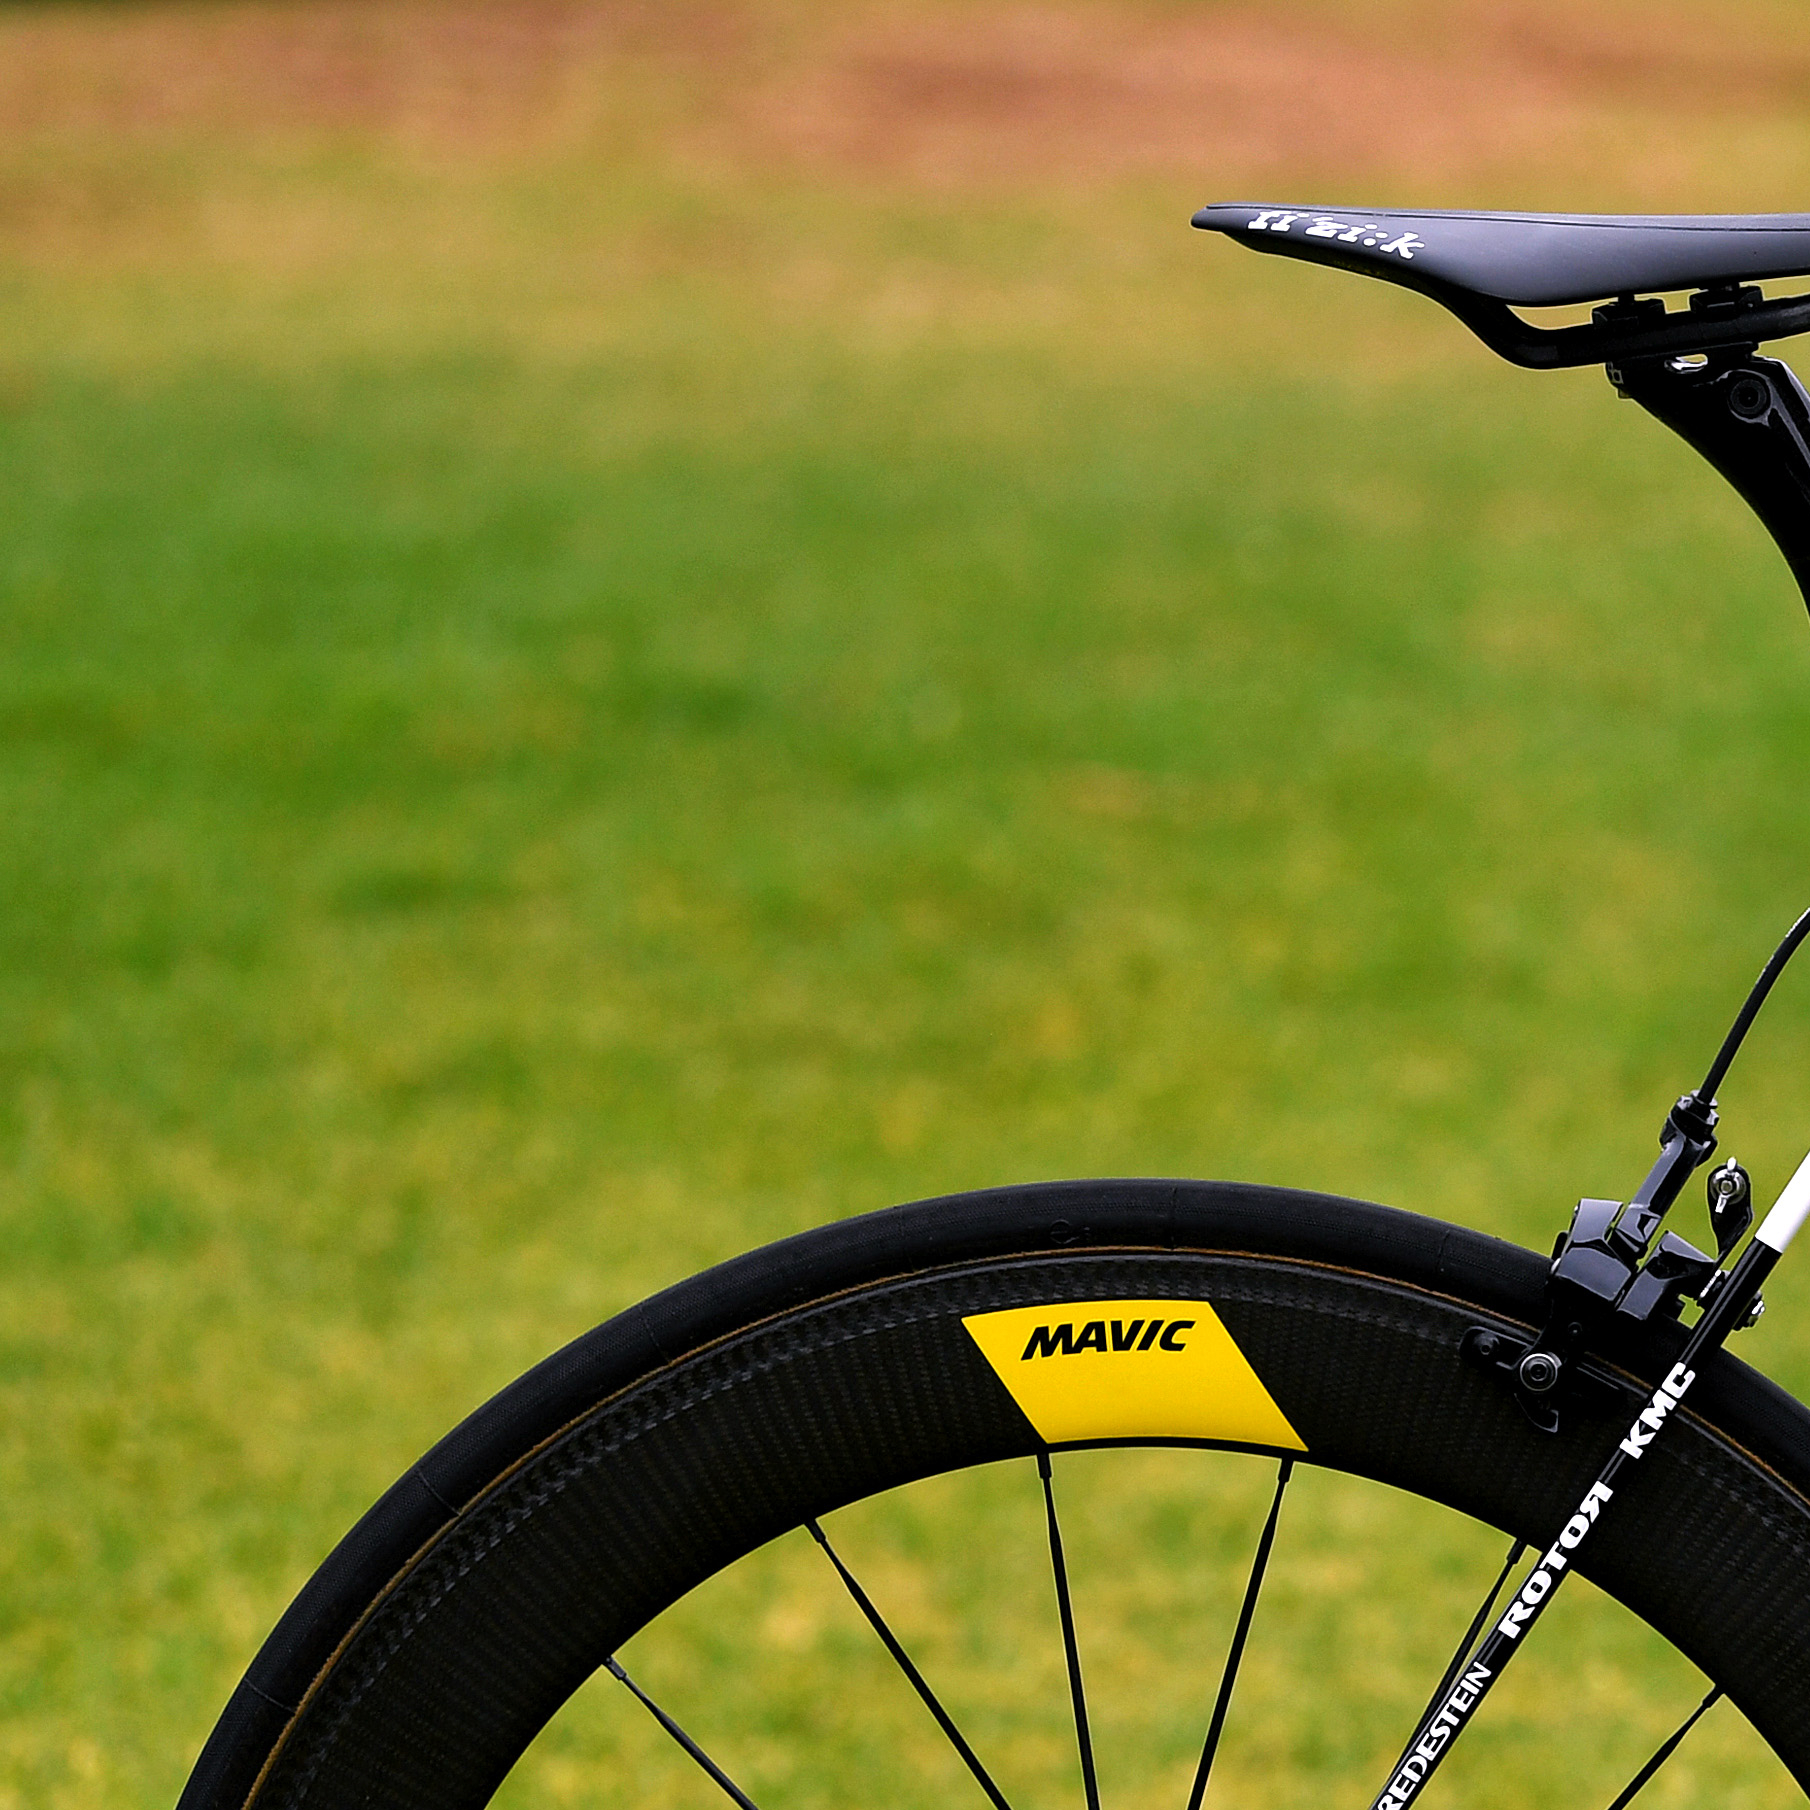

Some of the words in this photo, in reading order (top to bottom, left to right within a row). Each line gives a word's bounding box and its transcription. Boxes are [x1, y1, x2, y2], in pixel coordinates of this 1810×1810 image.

[1021, 1320, 1195, 1360] MAVIC
[1620, 1363, 1695, 1459] KMC
[1498, 1480, 1613, 1639] ROTOR
